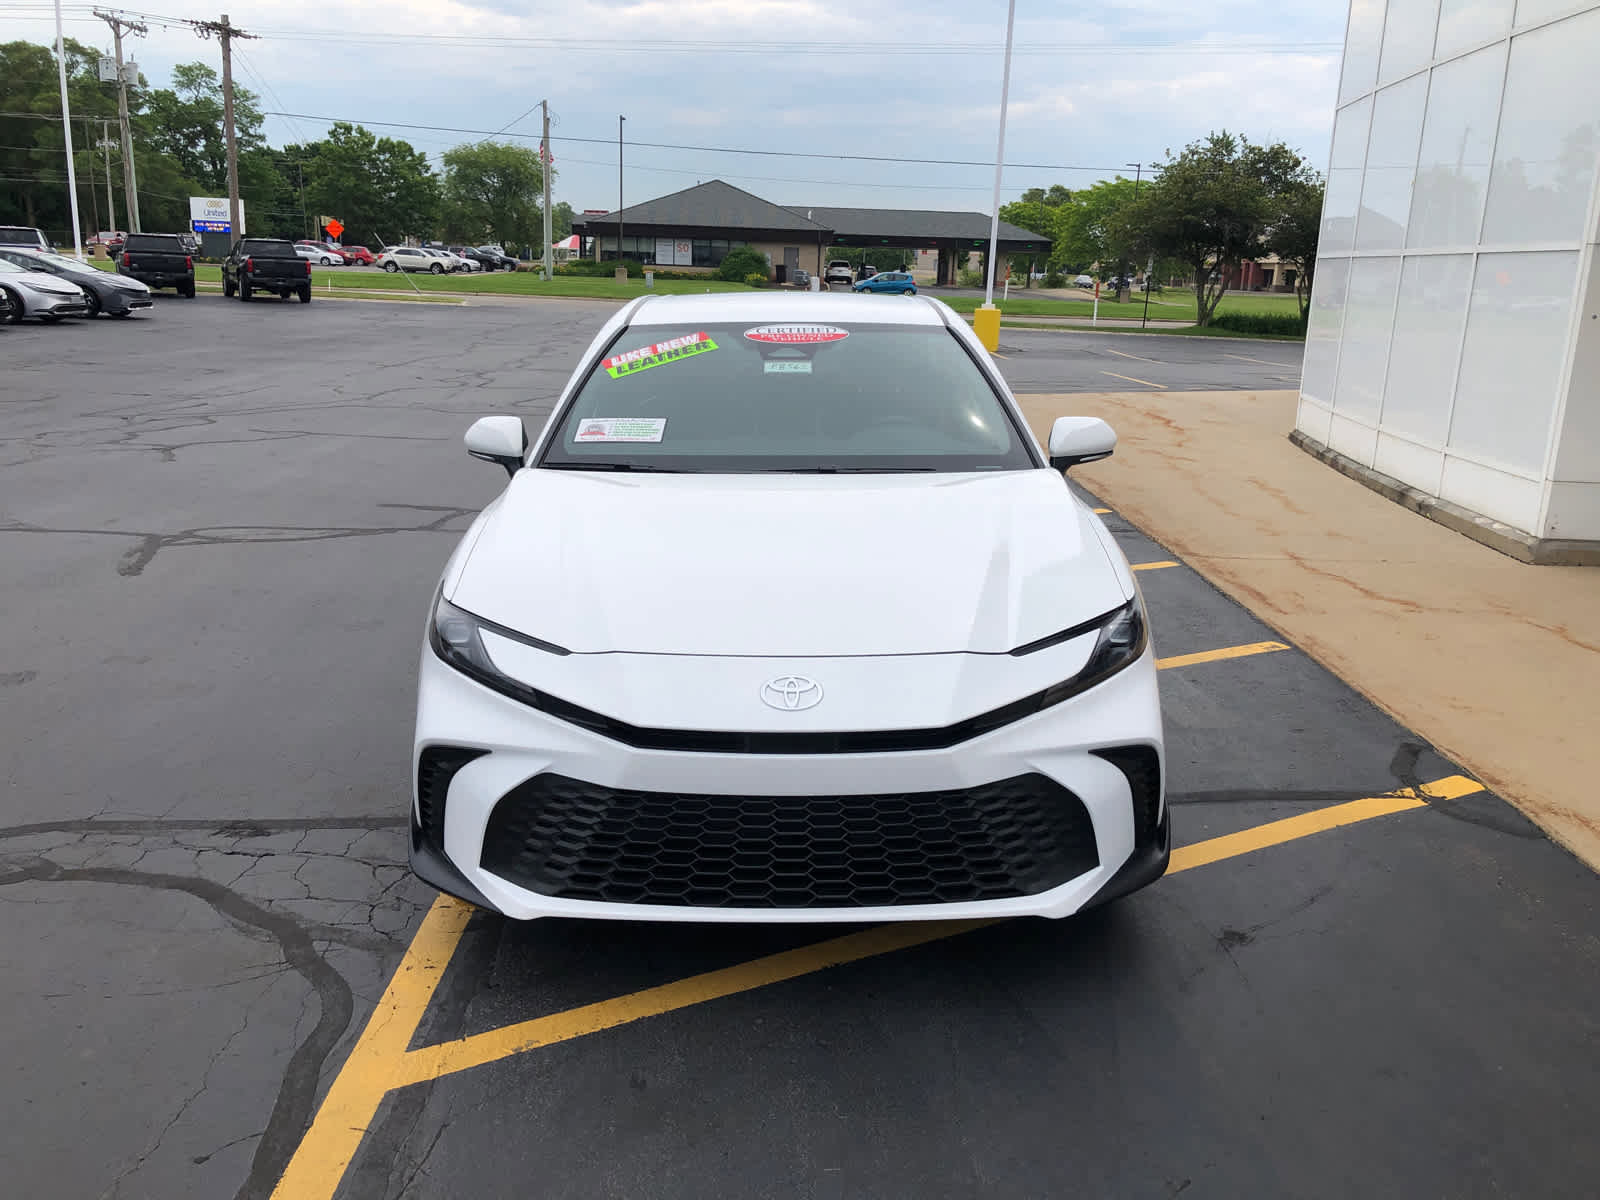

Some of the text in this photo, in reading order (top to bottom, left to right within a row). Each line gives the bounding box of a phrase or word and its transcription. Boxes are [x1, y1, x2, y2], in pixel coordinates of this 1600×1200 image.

[203, 209, 228, 217] United
[610, 332, 700, 367] LIKE NEW
[616, 341, 712, 375] LEATHER
